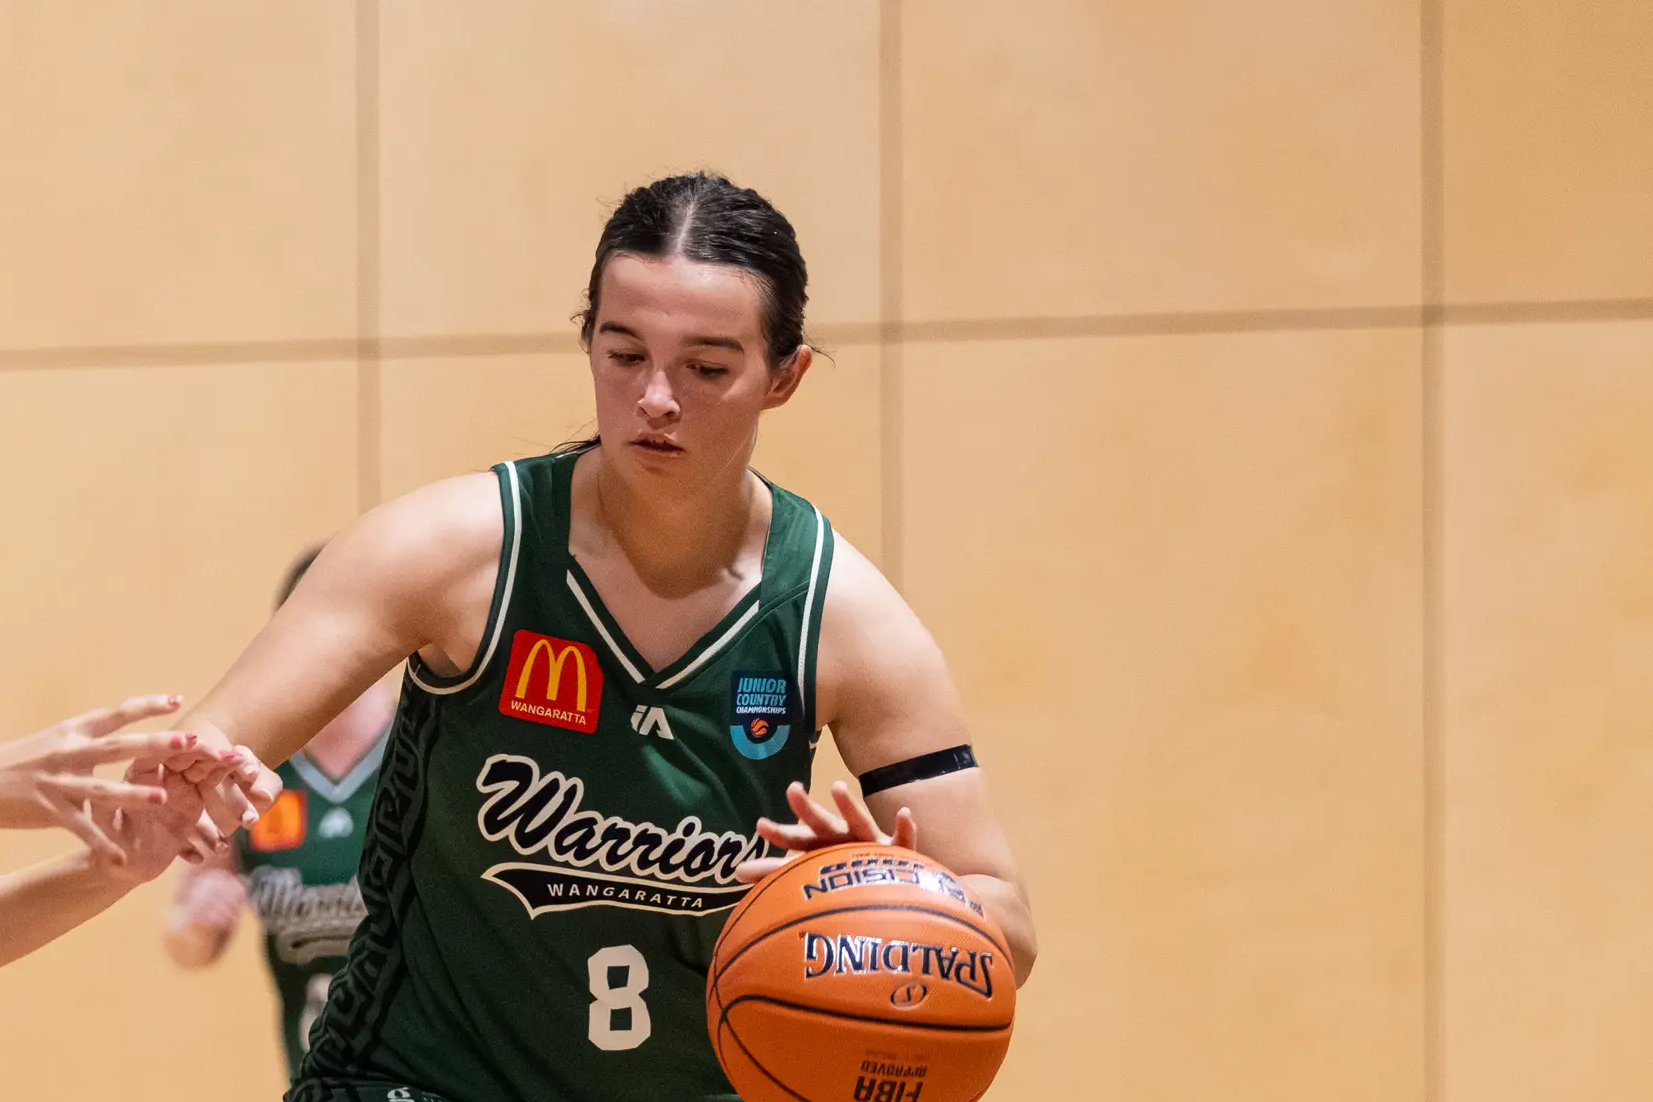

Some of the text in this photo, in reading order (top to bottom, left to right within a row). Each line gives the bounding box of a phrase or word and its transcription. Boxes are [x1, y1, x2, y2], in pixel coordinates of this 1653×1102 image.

[737, 677, 787, 694] JUNIOR
[736, 693, 787, 706] COUNTRY
[736, 706, 787, 715] CHAMPIONSHIPS
[510, 699, 587, 726] WANGARATTA
[547, 883, 704, 909] WANGARATTA
[804, 932, 994, 1000] SPALDING
[588, 944, 651, 1051] 8
[860, 1060, 928, 1078] APPROVED
